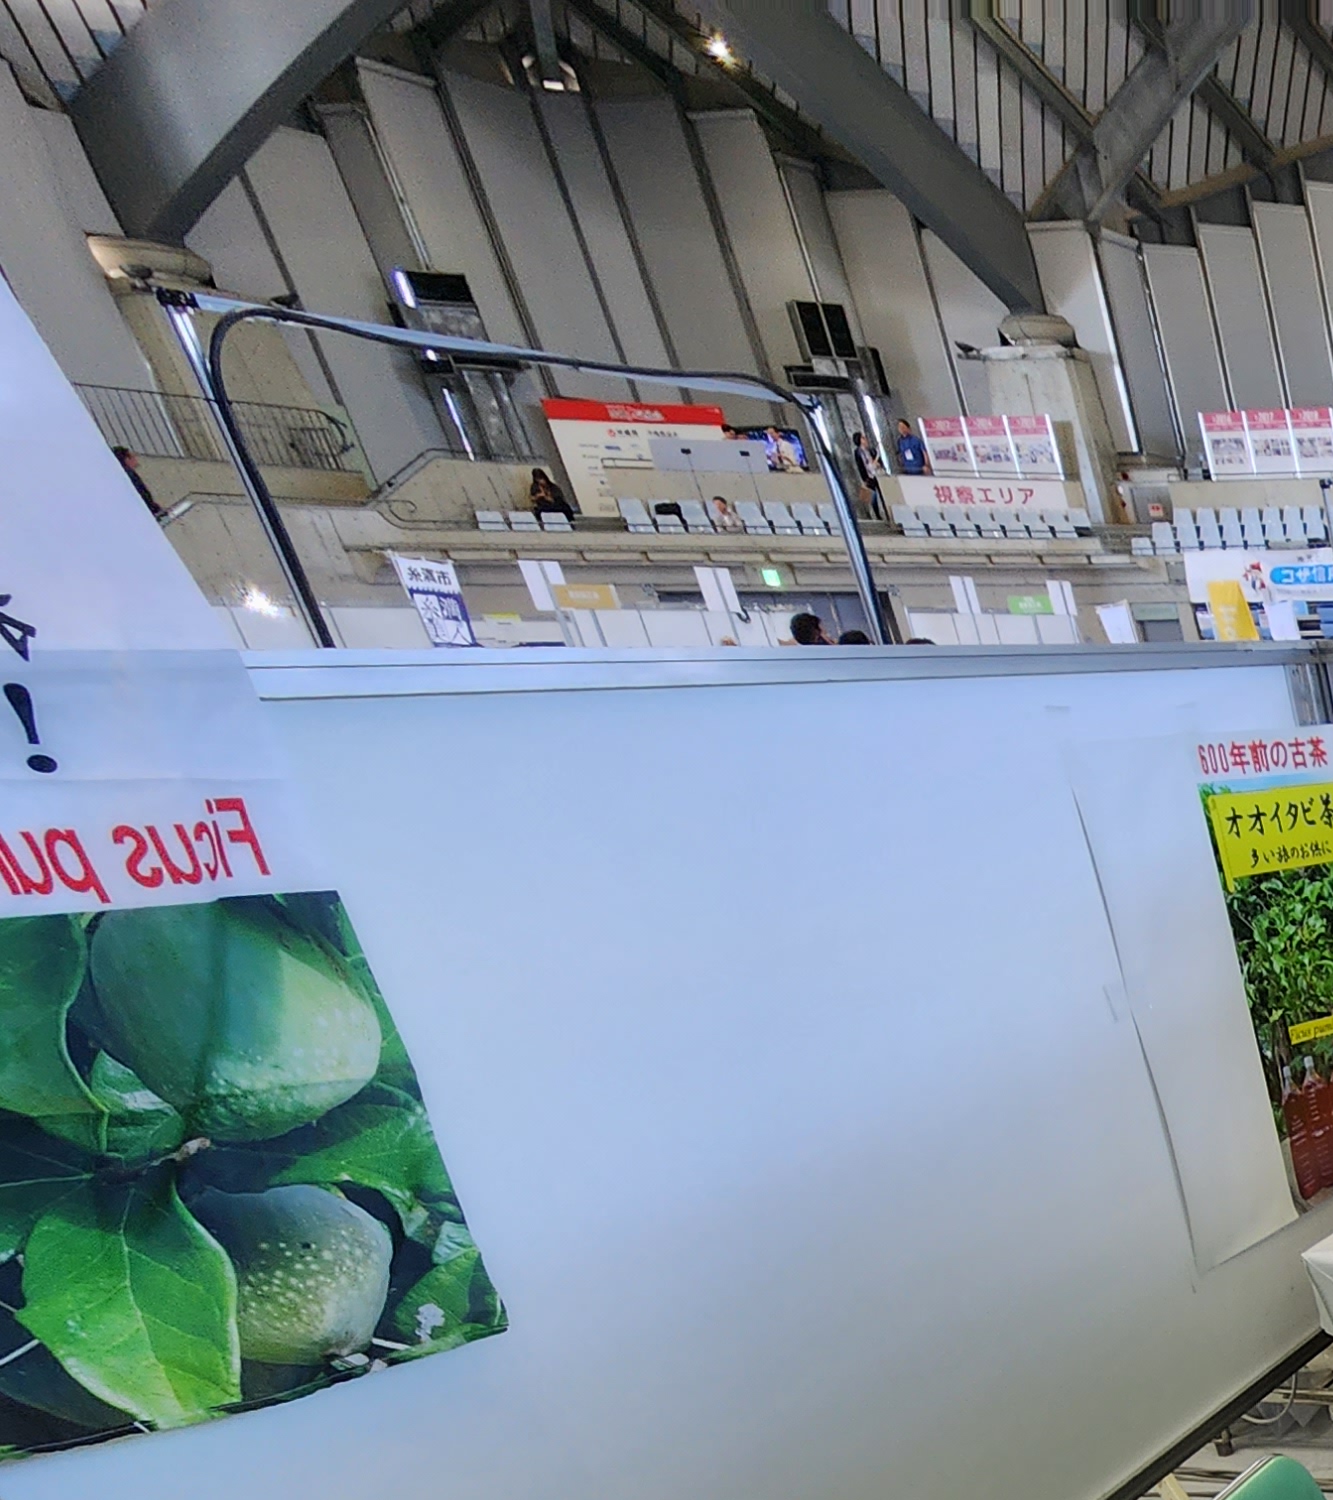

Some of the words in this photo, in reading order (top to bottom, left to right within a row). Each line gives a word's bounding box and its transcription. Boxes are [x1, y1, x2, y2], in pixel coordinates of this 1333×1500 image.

[933, 485, 1034, 505] 視察エリア
[1198, 736, 1329, 776] 600年前の古茶
